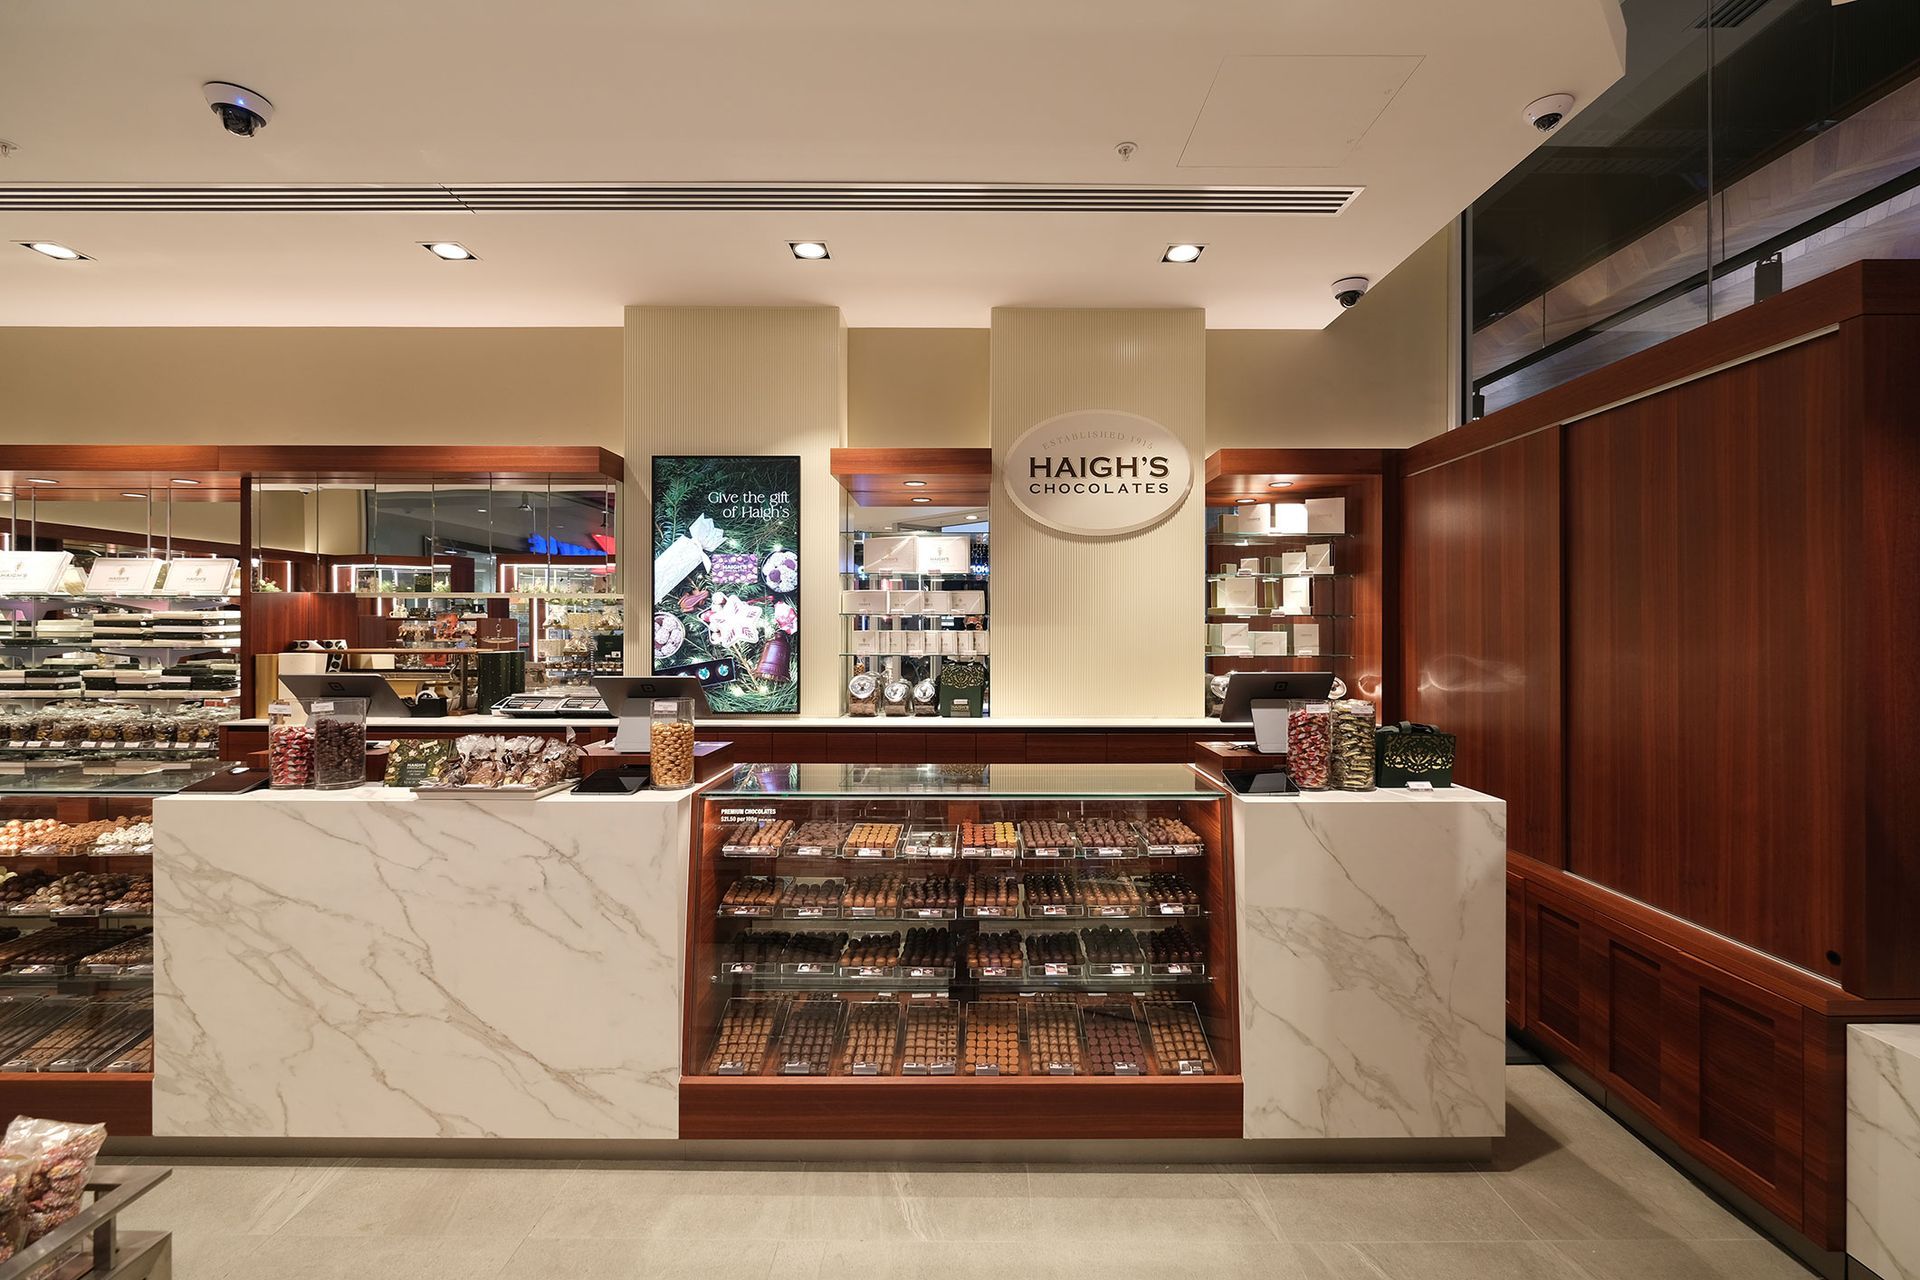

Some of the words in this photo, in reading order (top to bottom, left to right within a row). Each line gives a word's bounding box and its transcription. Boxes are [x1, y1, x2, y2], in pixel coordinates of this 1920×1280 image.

[1042, 431, 1125, 450] ESTABLISHED
[1029, 456, 1169, 478] HAIGH'S
[1029, 483, 1169, 494] CHOCOLATES
[708, 491, 739, 504] Give
[743, 491, 765, 504] the
[769, 491, 790, 507] gift
[723, 506, 738, 518] of
[742, 506, 790, 521] Haigh's
